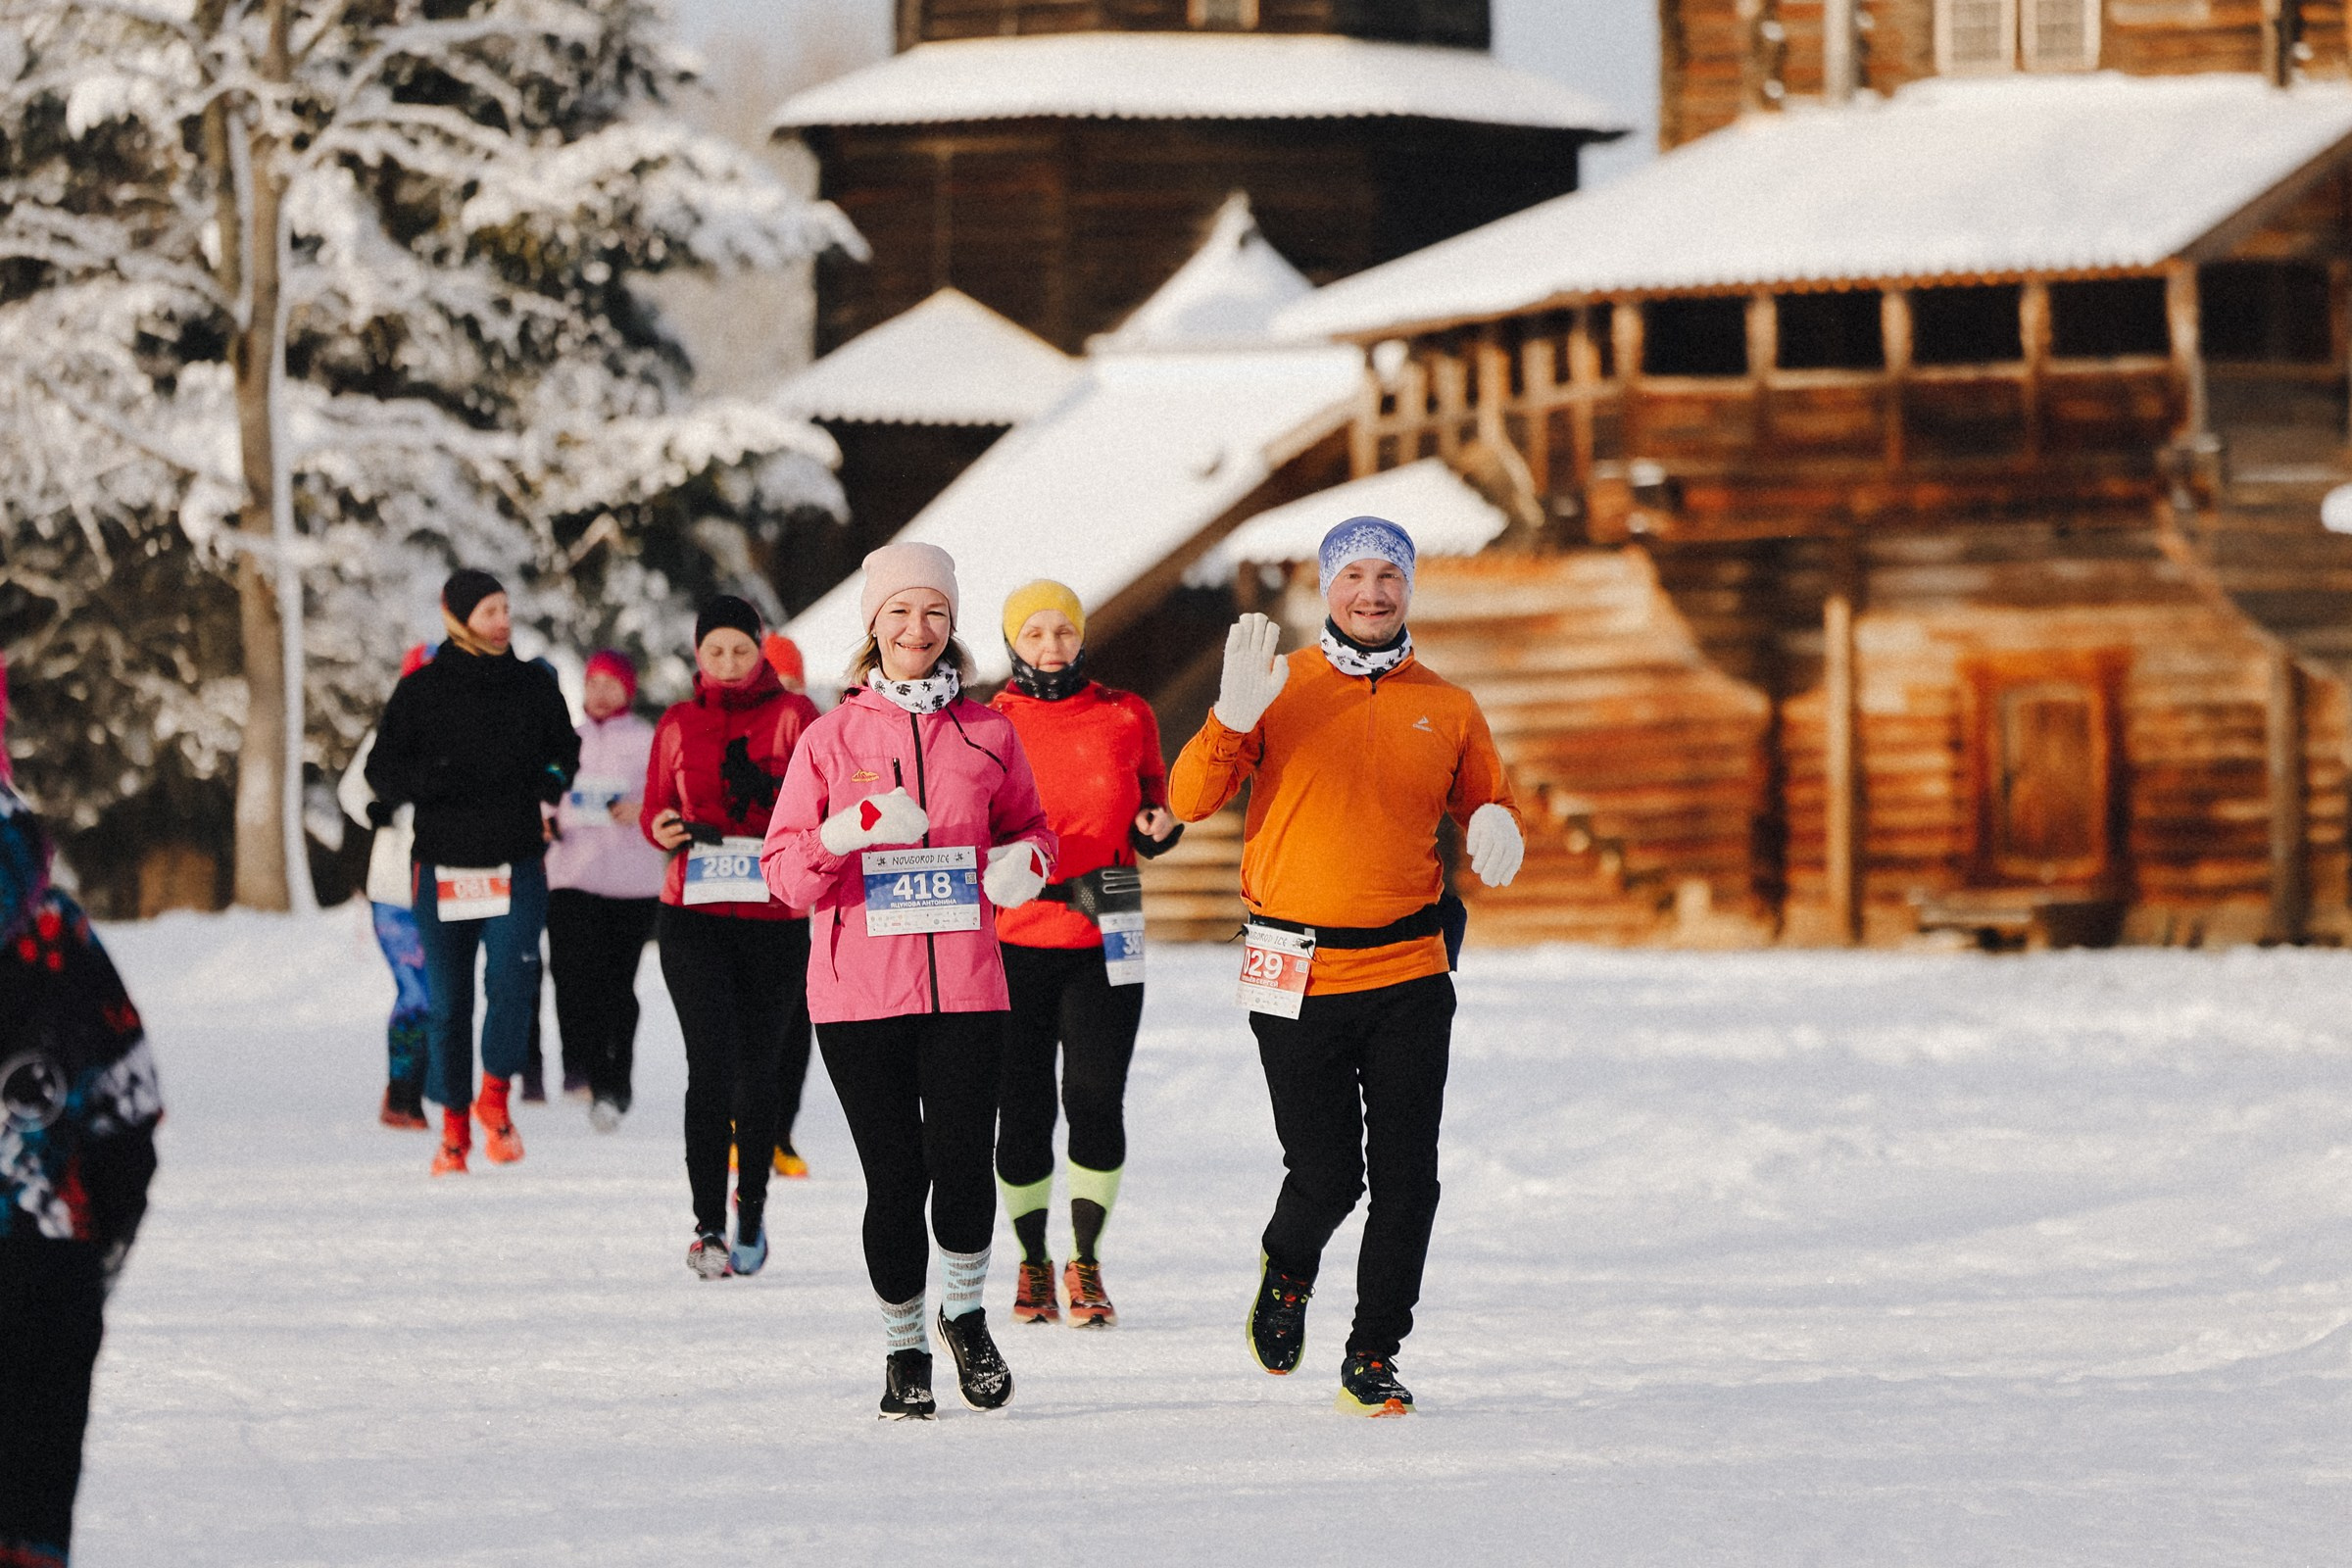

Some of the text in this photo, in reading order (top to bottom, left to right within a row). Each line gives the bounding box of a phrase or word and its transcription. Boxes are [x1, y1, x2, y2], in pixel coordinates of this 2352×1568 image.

[937, 854, 950, 863] ICE
[702, 856, 751, 878] 280
[893, 872, 953, 901] 418
[922, 898, 957, 906] АНТОНИНА
